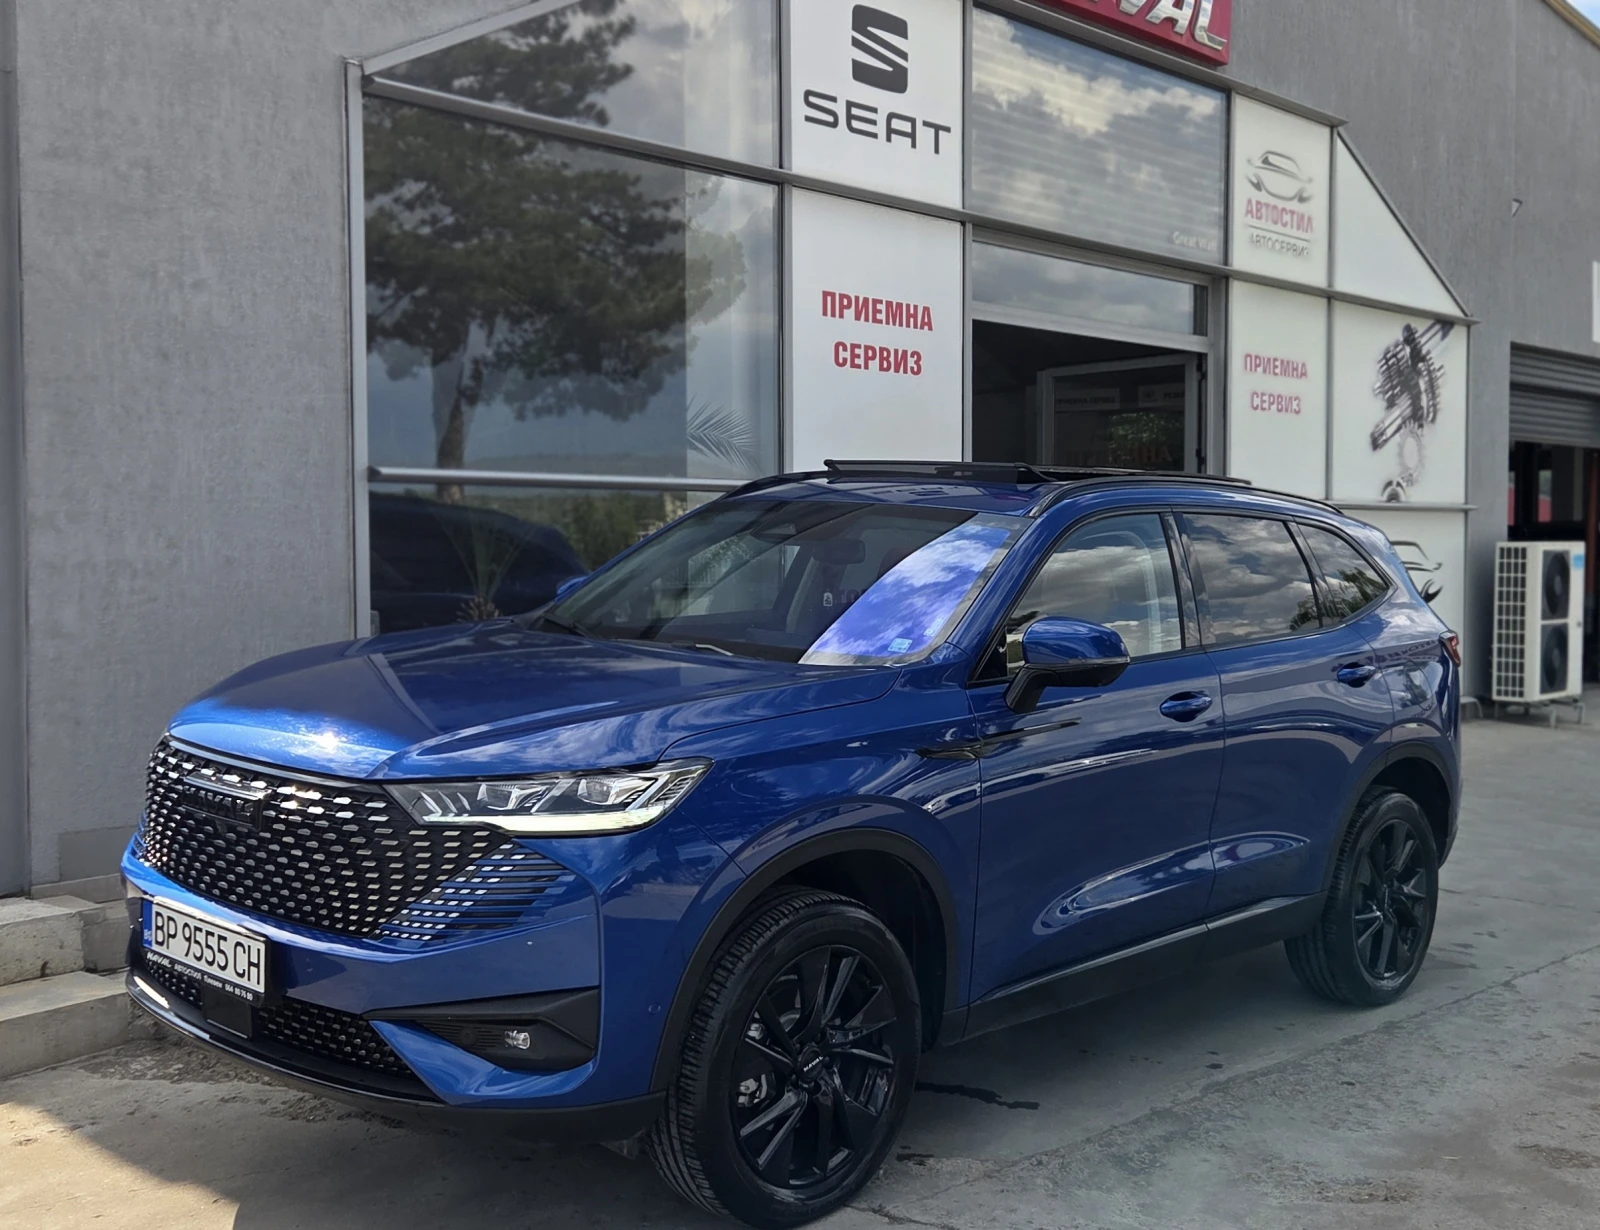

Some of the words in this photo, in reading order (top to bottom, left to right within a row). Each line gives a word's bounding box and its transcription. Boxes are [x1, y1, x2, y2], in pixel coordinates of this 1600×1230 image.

[804, 89, 951, 155] SEAT
[1245, 198, 1313, 233] АВТОСТИЛ
[822, 290, 933, 331] ПРИЕМНА
[834, 341, 922, 376] СЕРВИЗ
[1244, 353, 1308, 379] ПРИЕМНА
[1251, 391, 1302, 415] СЕРВИЗ
[155, 911, 177, 950] BP
[182, 922, 228, 971] 9555
[233, 941, 260, 985] CH
